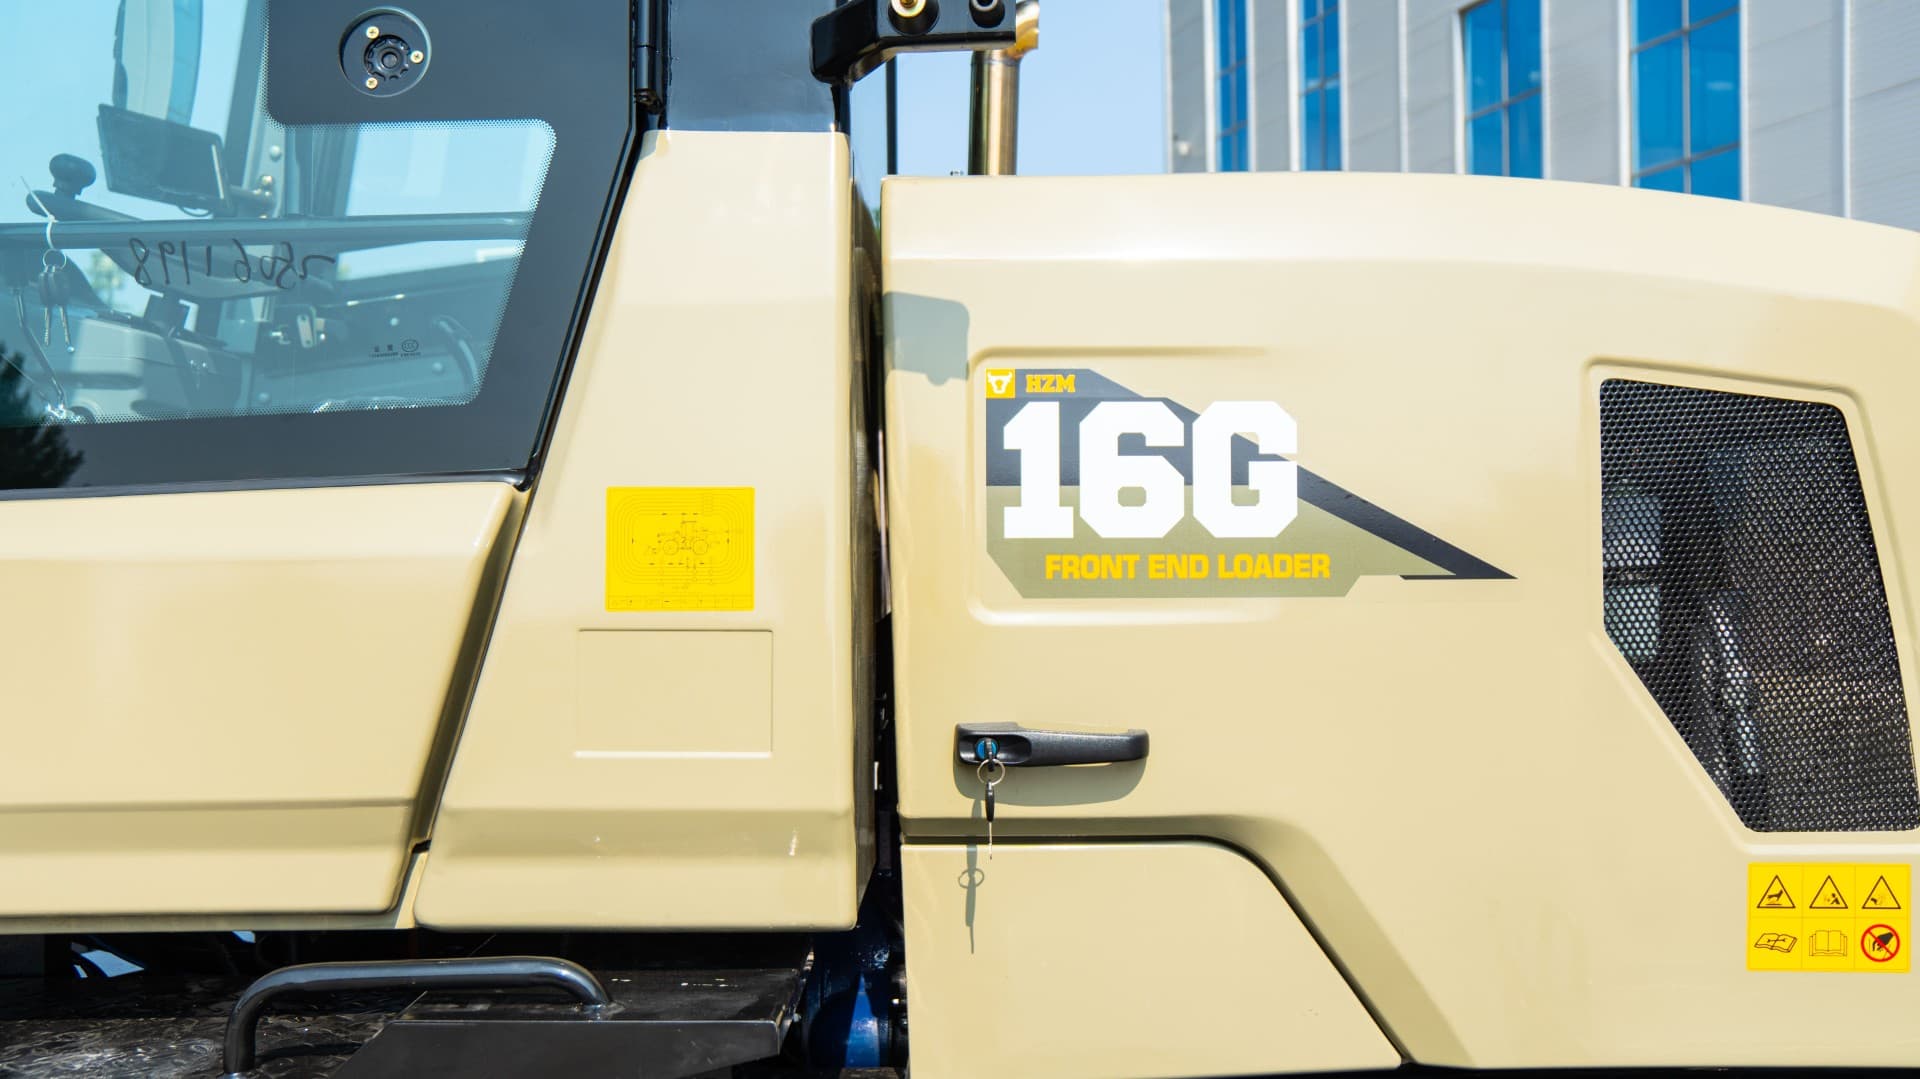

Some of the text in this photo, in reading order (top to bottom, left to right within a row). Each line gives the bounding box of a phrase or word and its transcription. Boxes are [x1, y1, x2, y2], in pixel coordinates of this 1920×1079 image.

[1025, 374, 1076, 393] HZM
[1003, 400, 1298, 539] 16G
[1045, 553, 1331, 580] FRONT END LOADER
